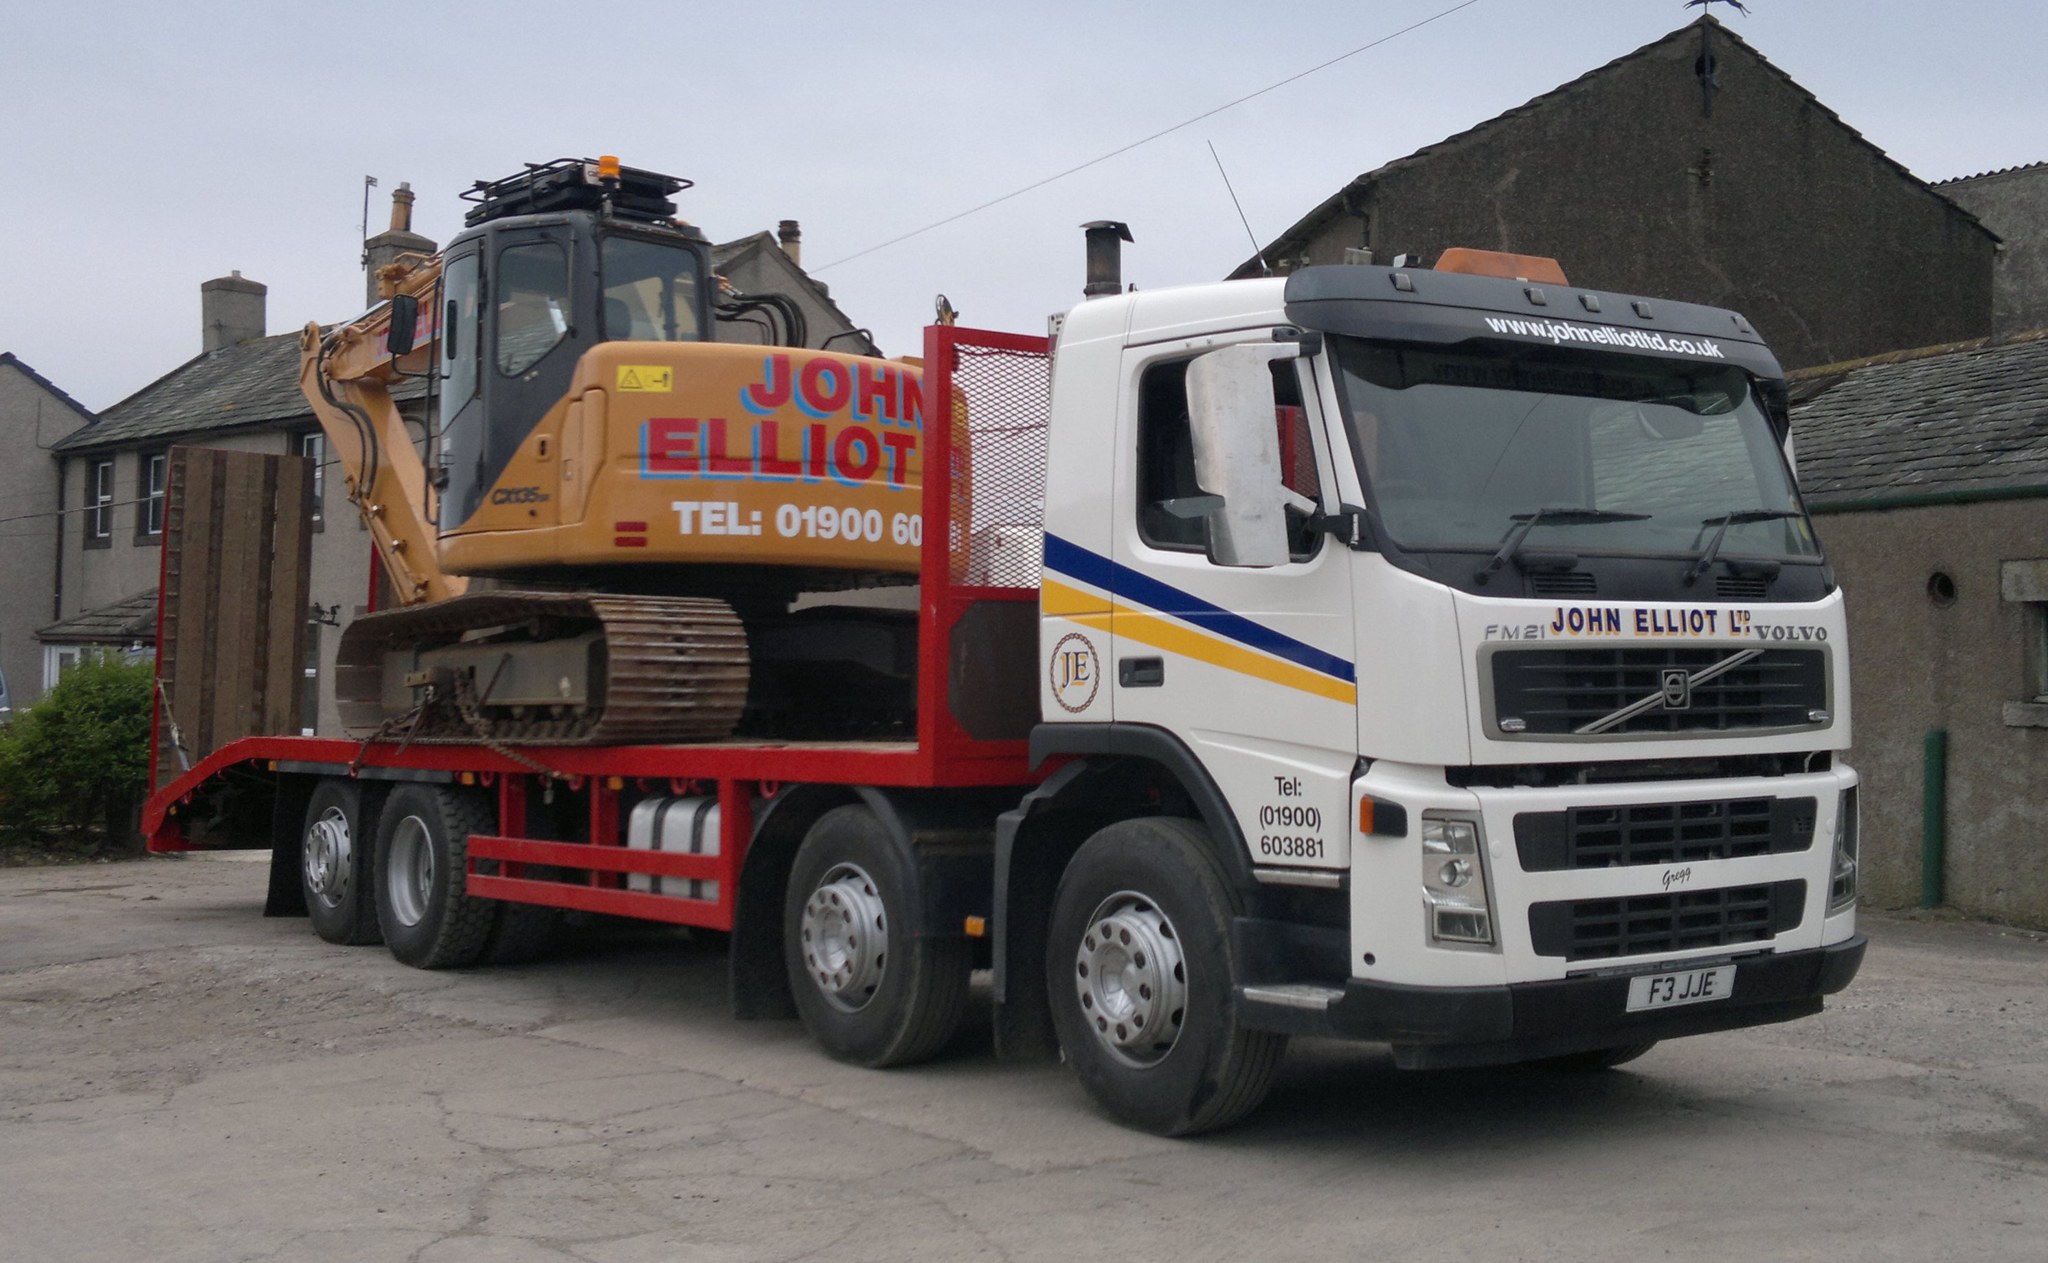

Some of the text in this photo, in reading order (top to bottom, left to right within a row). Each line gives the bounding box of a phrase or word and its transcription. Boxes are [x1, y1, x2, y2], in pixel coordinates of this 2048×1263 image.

[1485, 317, 1725, 359] www.johnelliotltd.co.uk
[740, 353, 923, 427] JOHN
[639, 418, 916, 490] ELLIOT
[671, 501, 762, 535] TEL:
[776, 503, 883, 541] 01900
[1551, 607, 1621, 637] JOHN
[1633, 608, 1718, 637] ELLIOT
[1753, 625, 1828, 641] VOLVO
[1274, 777, 1302, 797] Tel:
[1259, 805, 1322, 831] (01900)
[1260, 836, 1324, 858] 603881
[1661, 866, 1692, 891] Gregg
[1648, 971, 1717, 1004] F3 JJE
